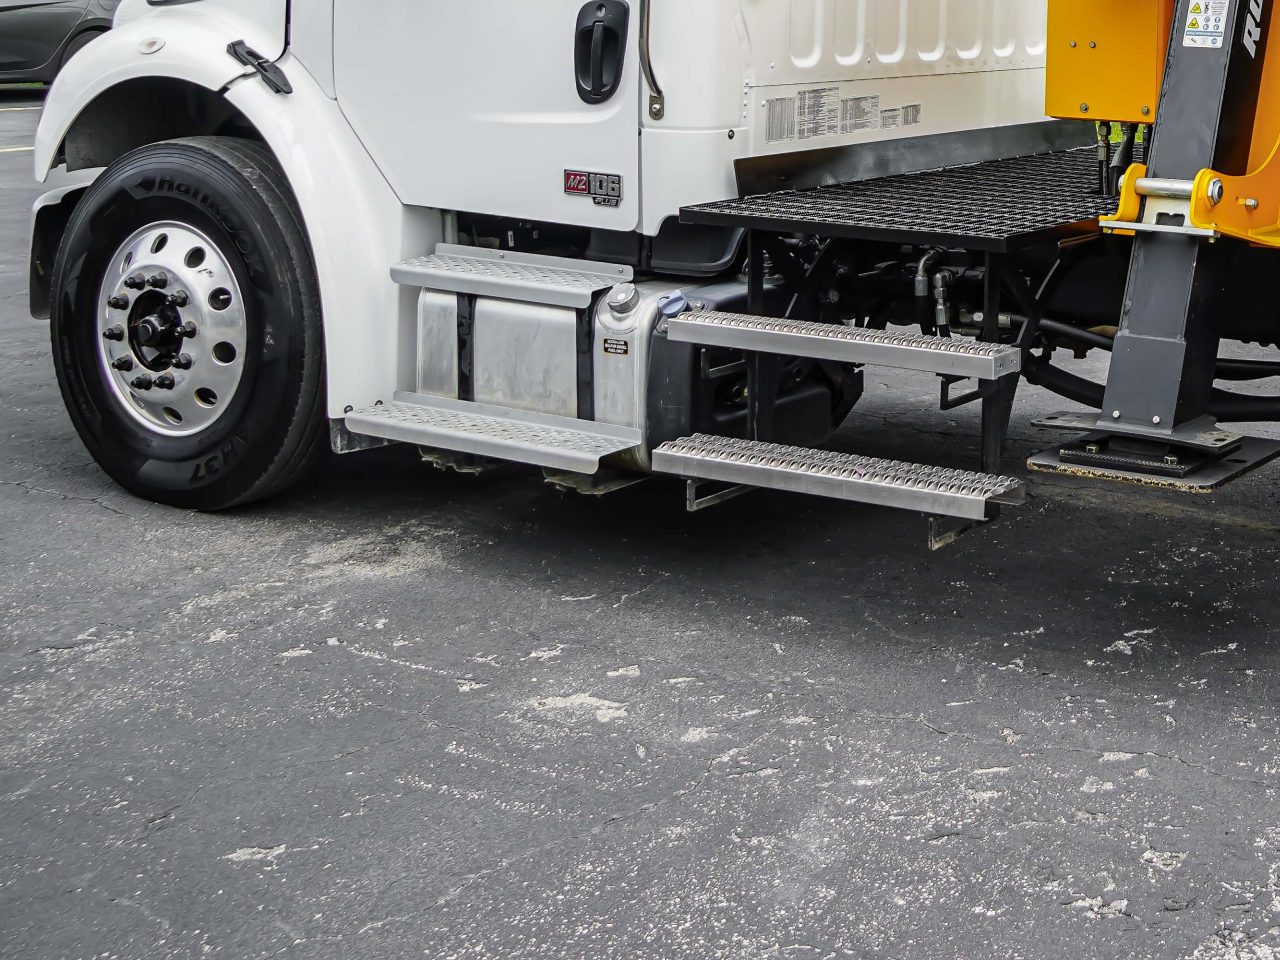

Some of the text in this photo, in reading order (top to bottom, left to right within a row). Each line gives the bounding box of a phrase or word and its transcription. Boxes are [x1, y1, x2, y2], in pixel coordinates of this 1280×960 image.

[567, 173, 620, 196] M2 106
[595, 197, 617, 206] PLUS
